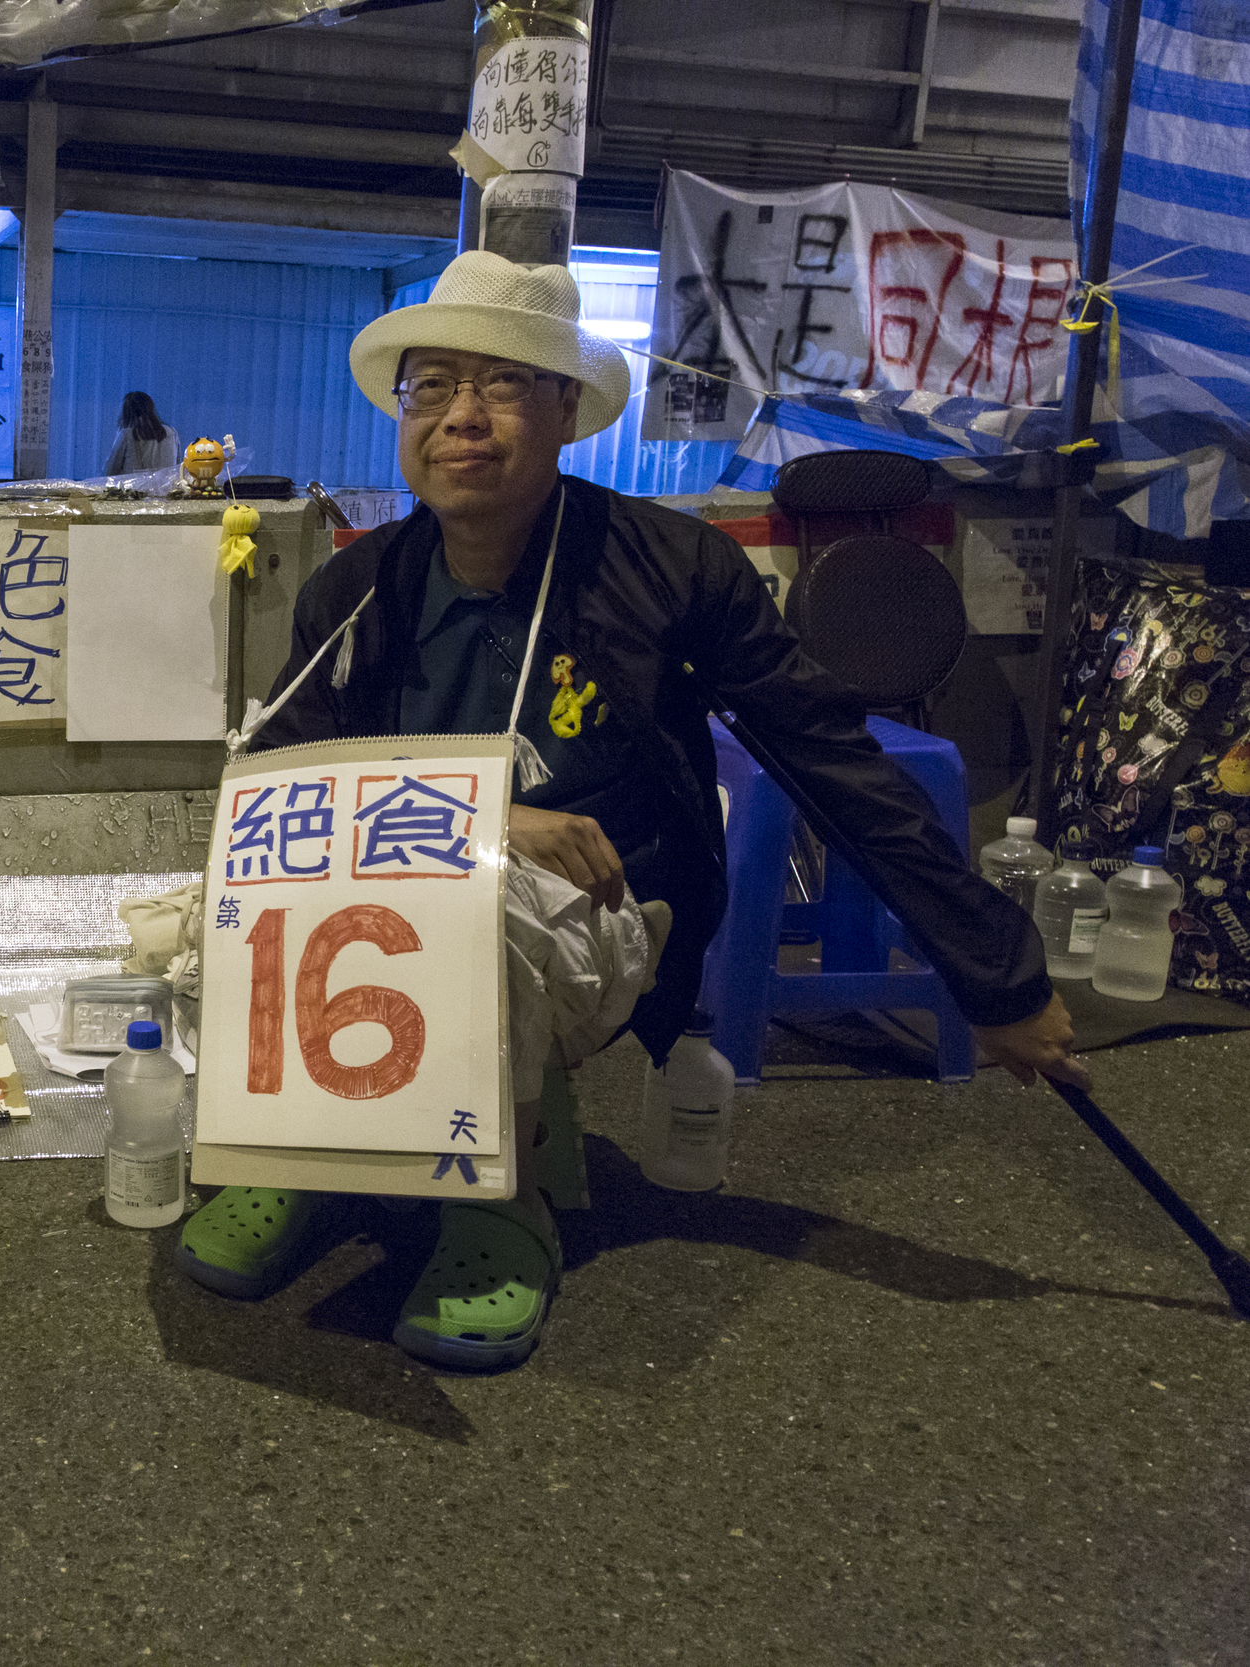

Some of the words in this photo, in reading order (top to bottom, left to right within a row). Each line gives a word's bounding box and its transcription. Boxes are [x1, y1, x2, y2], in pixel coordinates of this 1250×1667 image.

[1091, 857, 1130, 872] BUTTER
[215, 895, 242, 929] 第
[245, 904, 426, 1101] 16
[449, 1109, 478, 1144] 天
